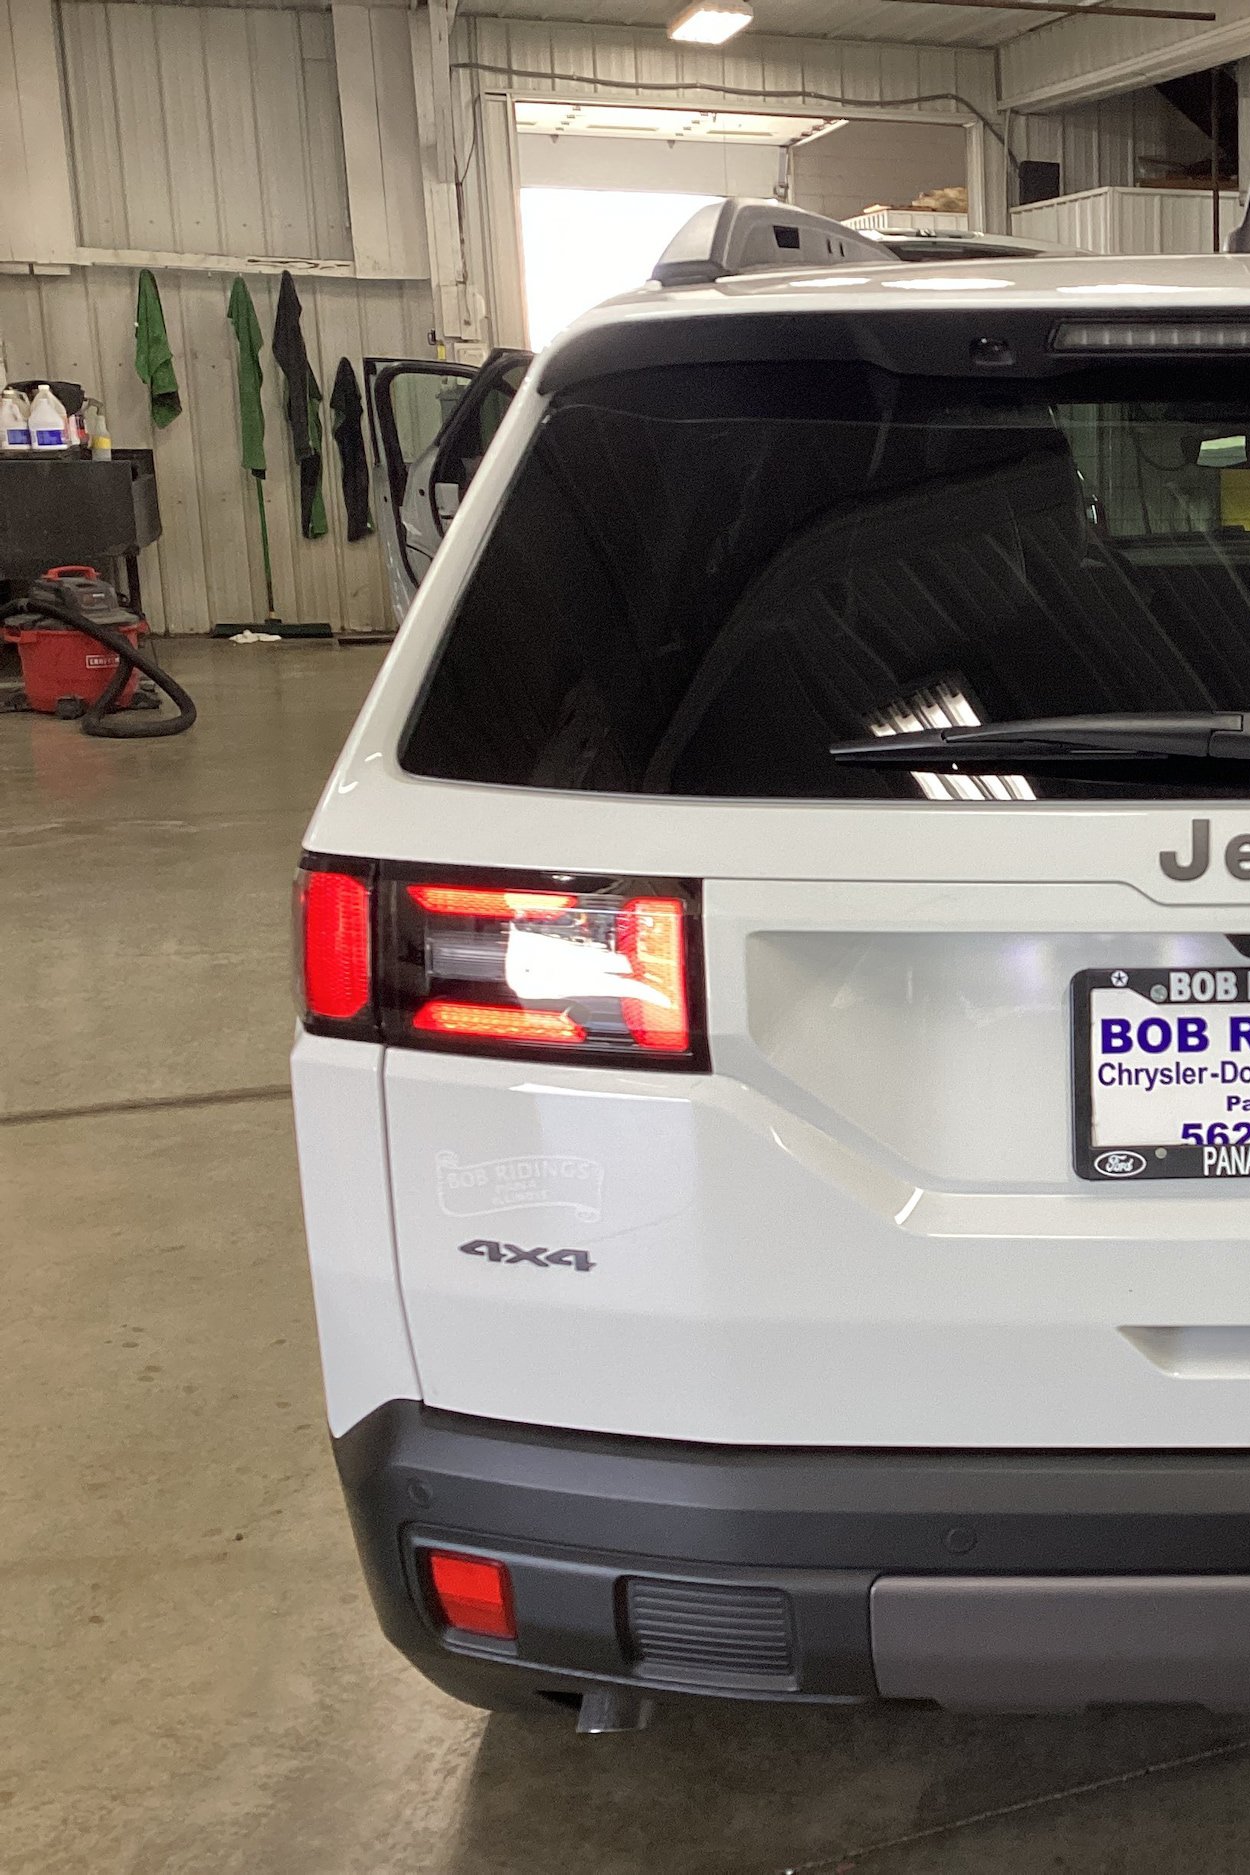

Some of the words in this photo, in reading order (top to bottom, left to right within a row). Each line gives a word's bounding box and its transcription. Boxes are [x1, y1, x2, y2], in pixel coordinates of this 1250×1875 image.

[1169, 970, 1239, 1002] BOB
[1101, 1016, 1210, 1054] BOB
[446, 1168, 489, 1190] BOB
[494, 1160, 591, 1182] RIDINGS
[1105, 1154, 1134, 1172] Ford
